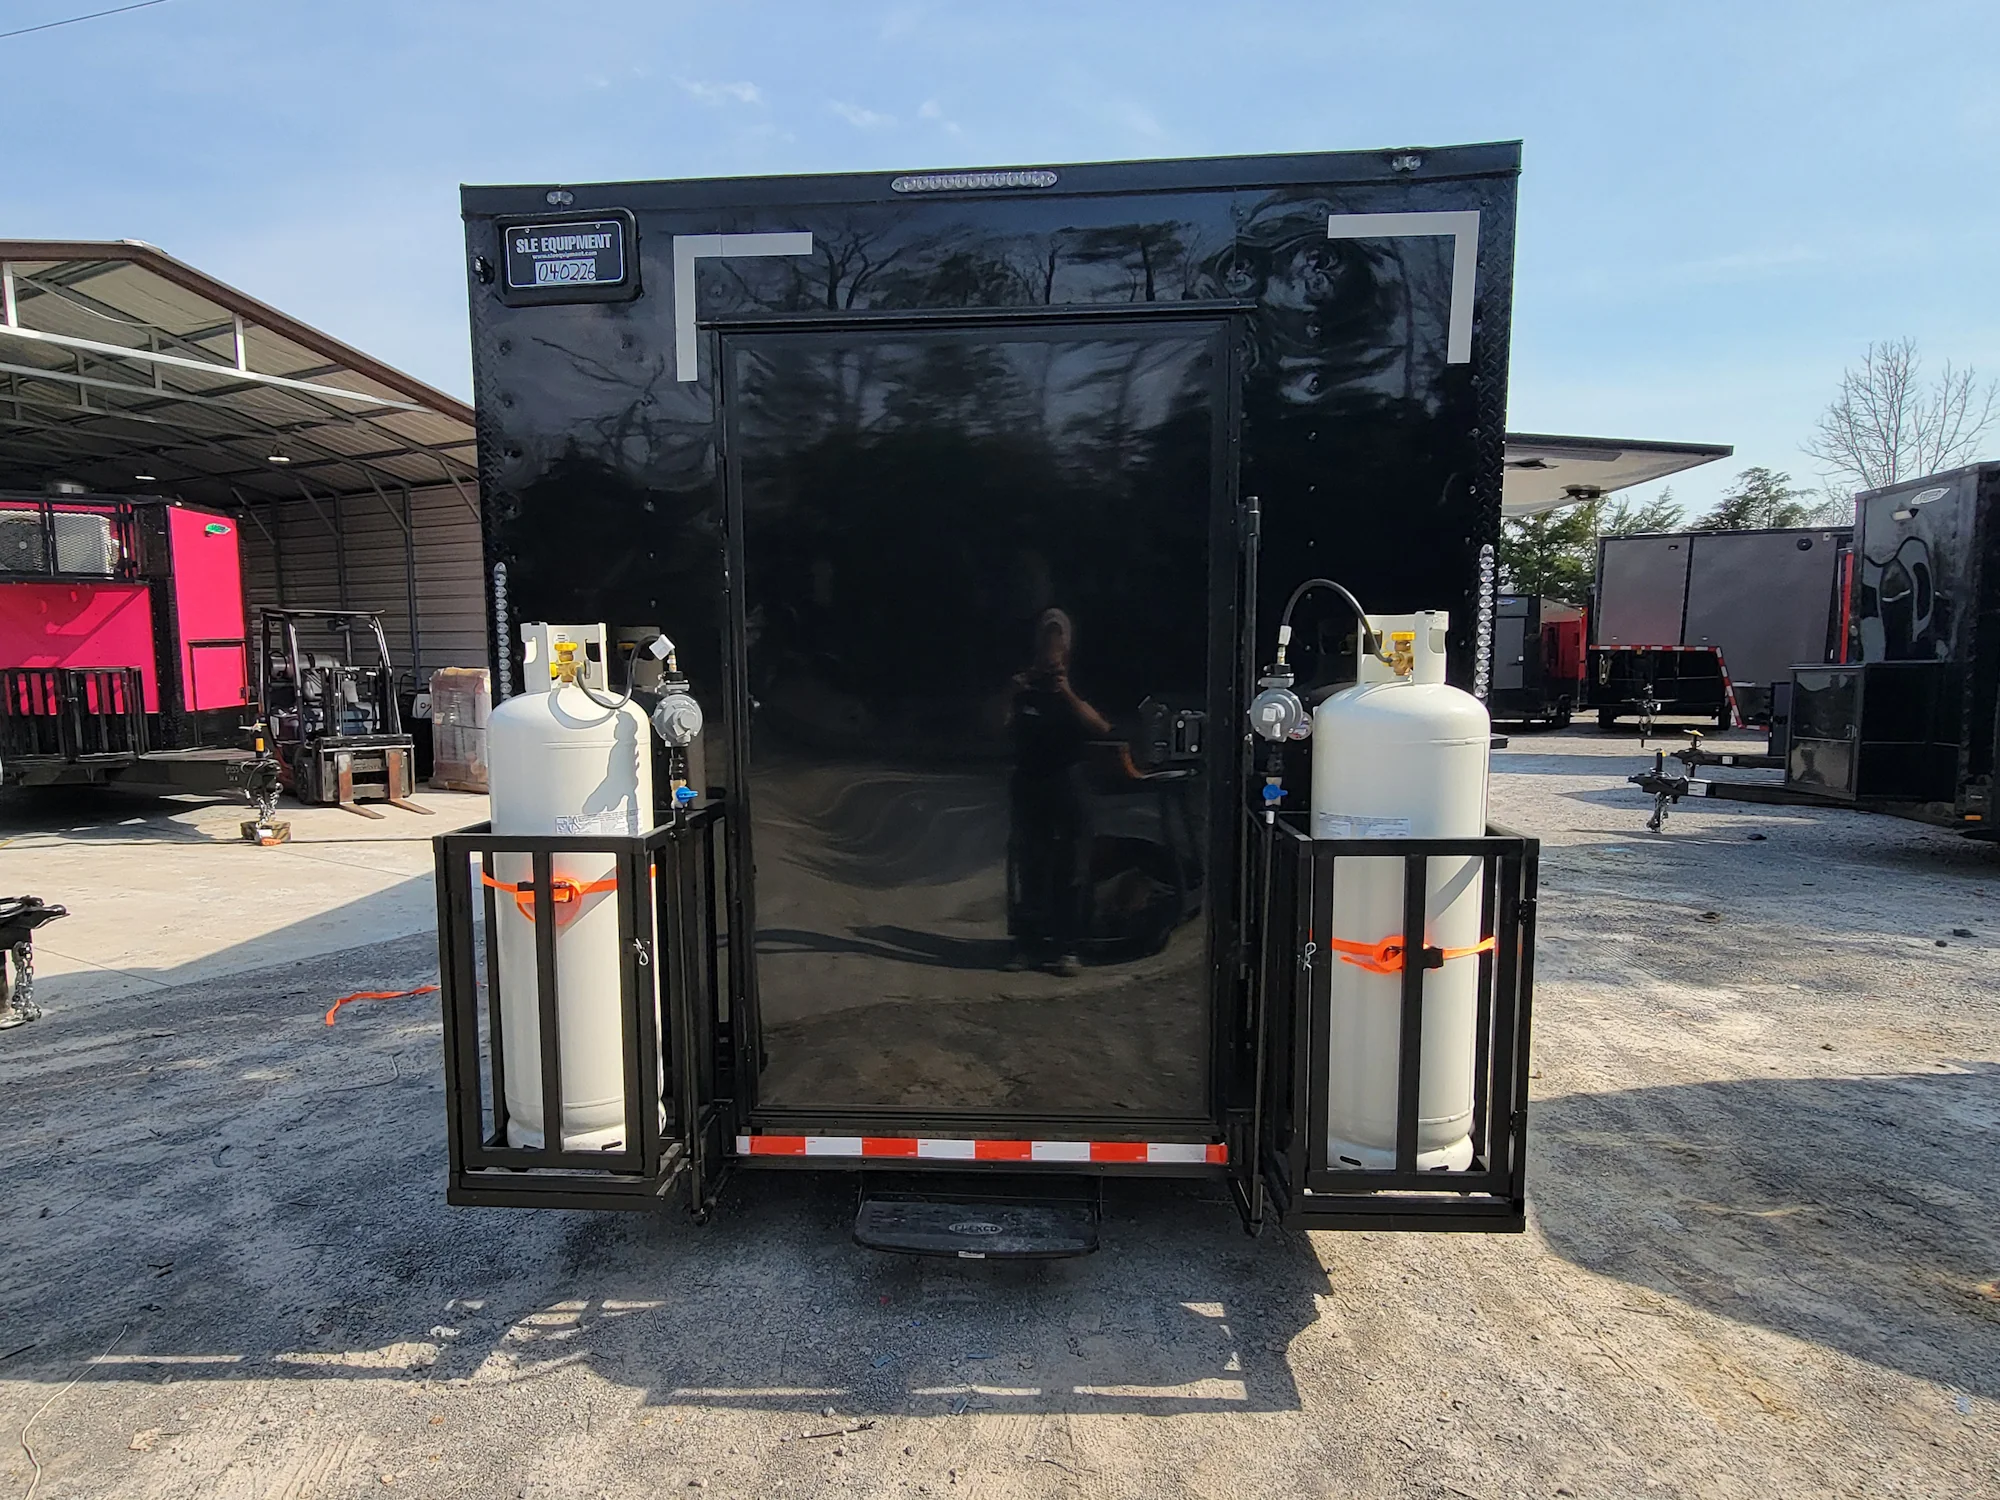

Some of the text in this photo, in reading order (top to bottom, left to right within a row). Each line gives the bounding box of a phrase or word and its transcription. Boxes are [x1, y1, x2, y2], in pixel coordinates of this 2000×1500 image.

[516, 233, 612, 254] SLE EQUIPMENT
[538, 262, 596, 282] 040226
